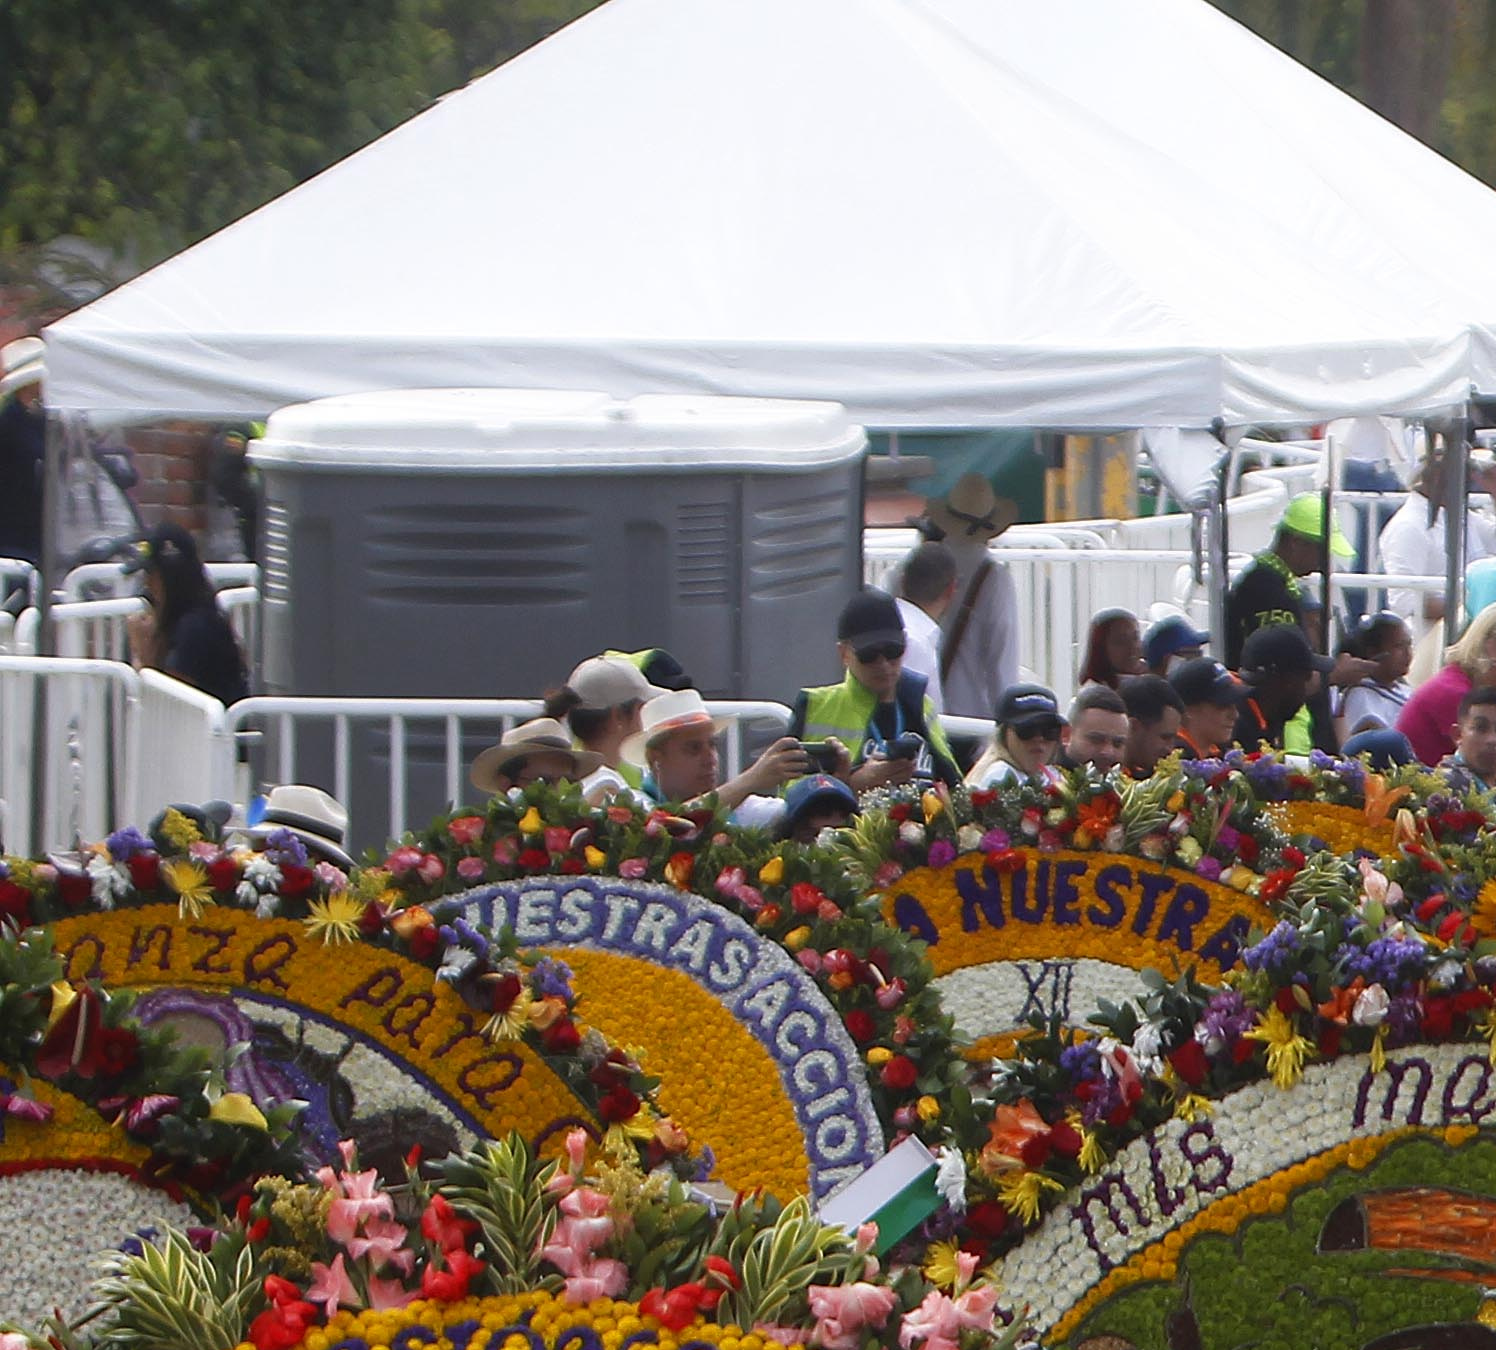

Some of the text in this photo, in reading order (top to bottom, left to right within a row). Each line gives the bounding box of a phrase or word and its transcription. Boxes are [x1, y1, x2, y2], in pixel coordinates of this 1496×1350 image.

[953, 857, 1253, 973] NUESTRA
[340, 965, 526, 1113] para
[1070, 1120, 1236, 1268] mis
